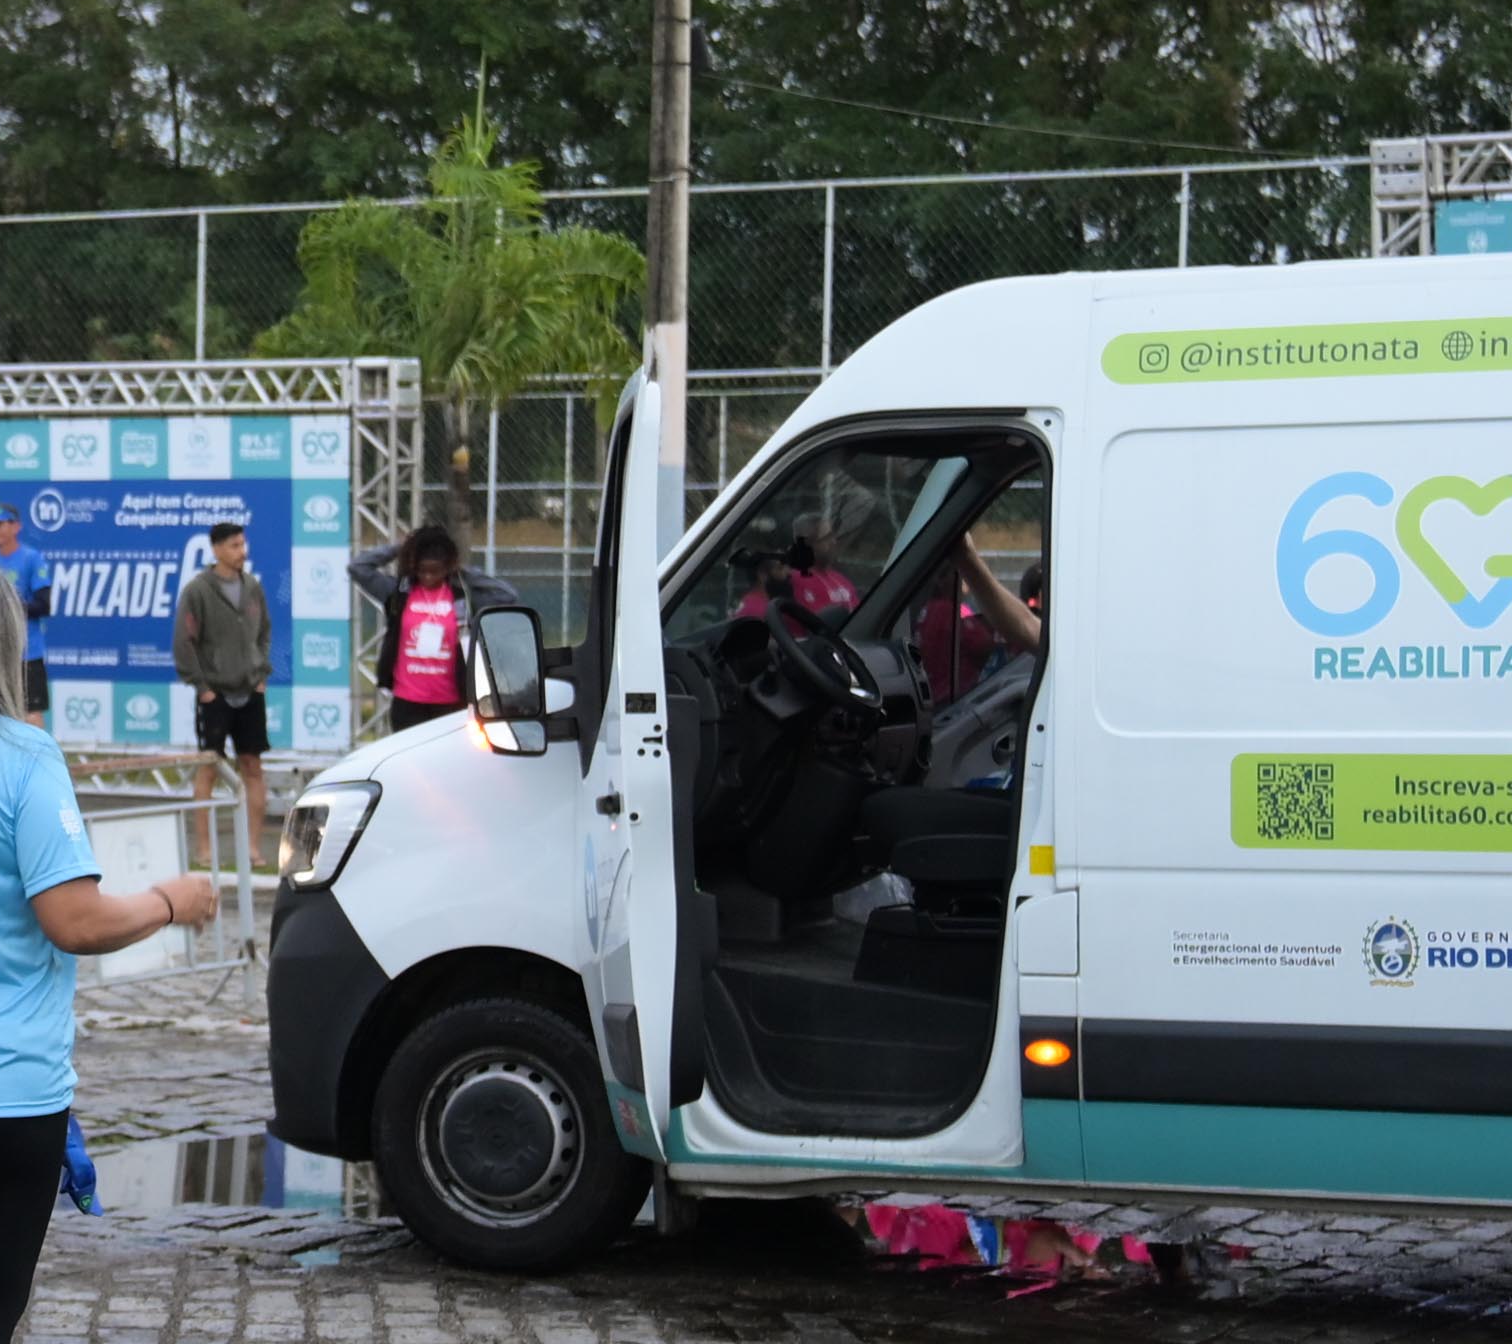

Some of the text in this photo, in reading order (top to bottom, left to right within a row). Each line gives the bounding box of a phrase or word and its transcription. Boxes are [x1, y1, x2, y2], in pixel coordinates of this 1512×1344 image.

[1180, 337, 1420, 373] @institutonata
[122, 493, 153, 512] Aqui
[156, 495, 181, 509] tem
[115, 510, 180, 529] Conquista
[49, 561, 178, 617] MIZADE
[1172, 931, 1230, 942] Secretaria
[1172, 943, 1343, 955] Intergeracional de Juventude
[1427, 947, 1479, 968] RIO
[1173, 955, 1335, 967] e Envelhecimento Saudável
